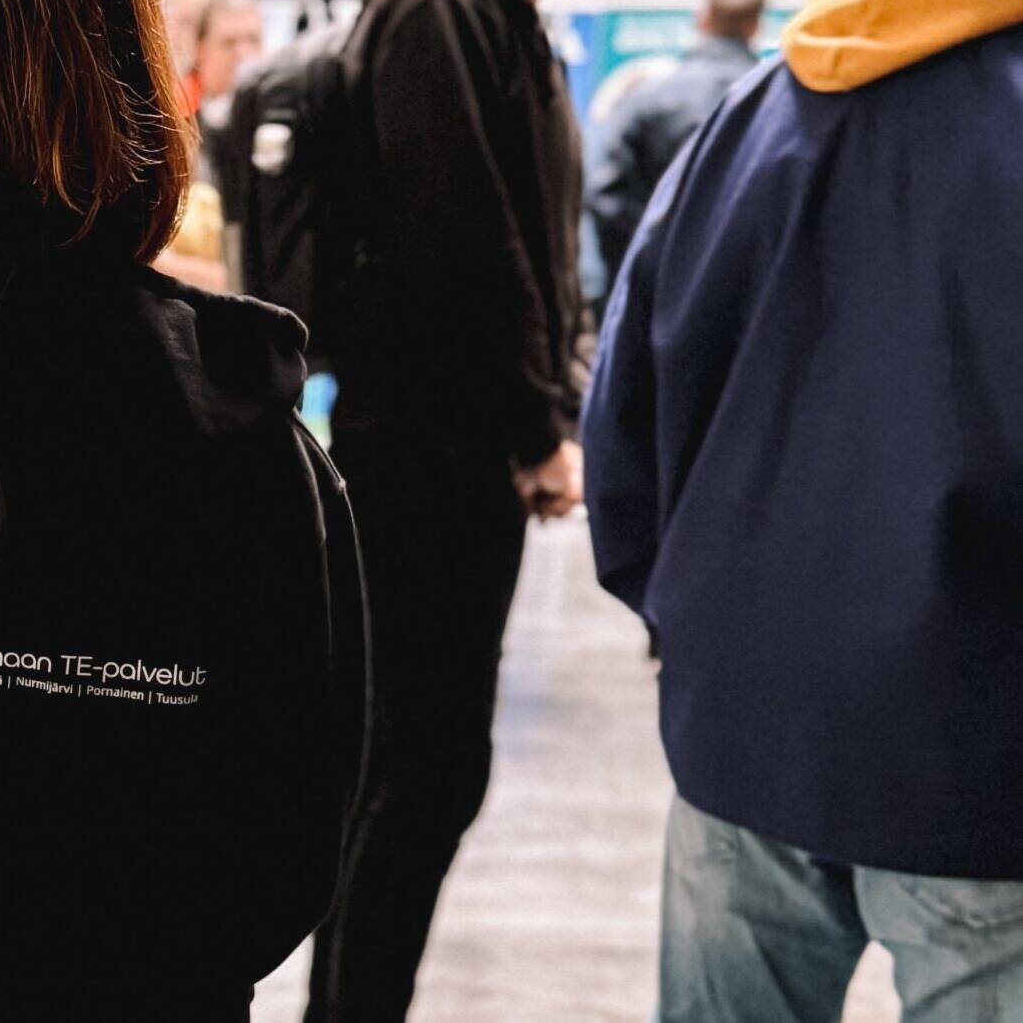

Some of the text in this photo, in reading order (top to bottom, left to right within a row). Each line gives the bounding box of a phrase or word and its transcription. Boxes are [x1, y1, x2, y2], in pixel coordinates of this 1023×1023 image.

[61, 654, 207, 686] TE-palvelut
[16, 676, 73, 694] Nurmijärvi
[86, 685, 145, 700] Pornainen
